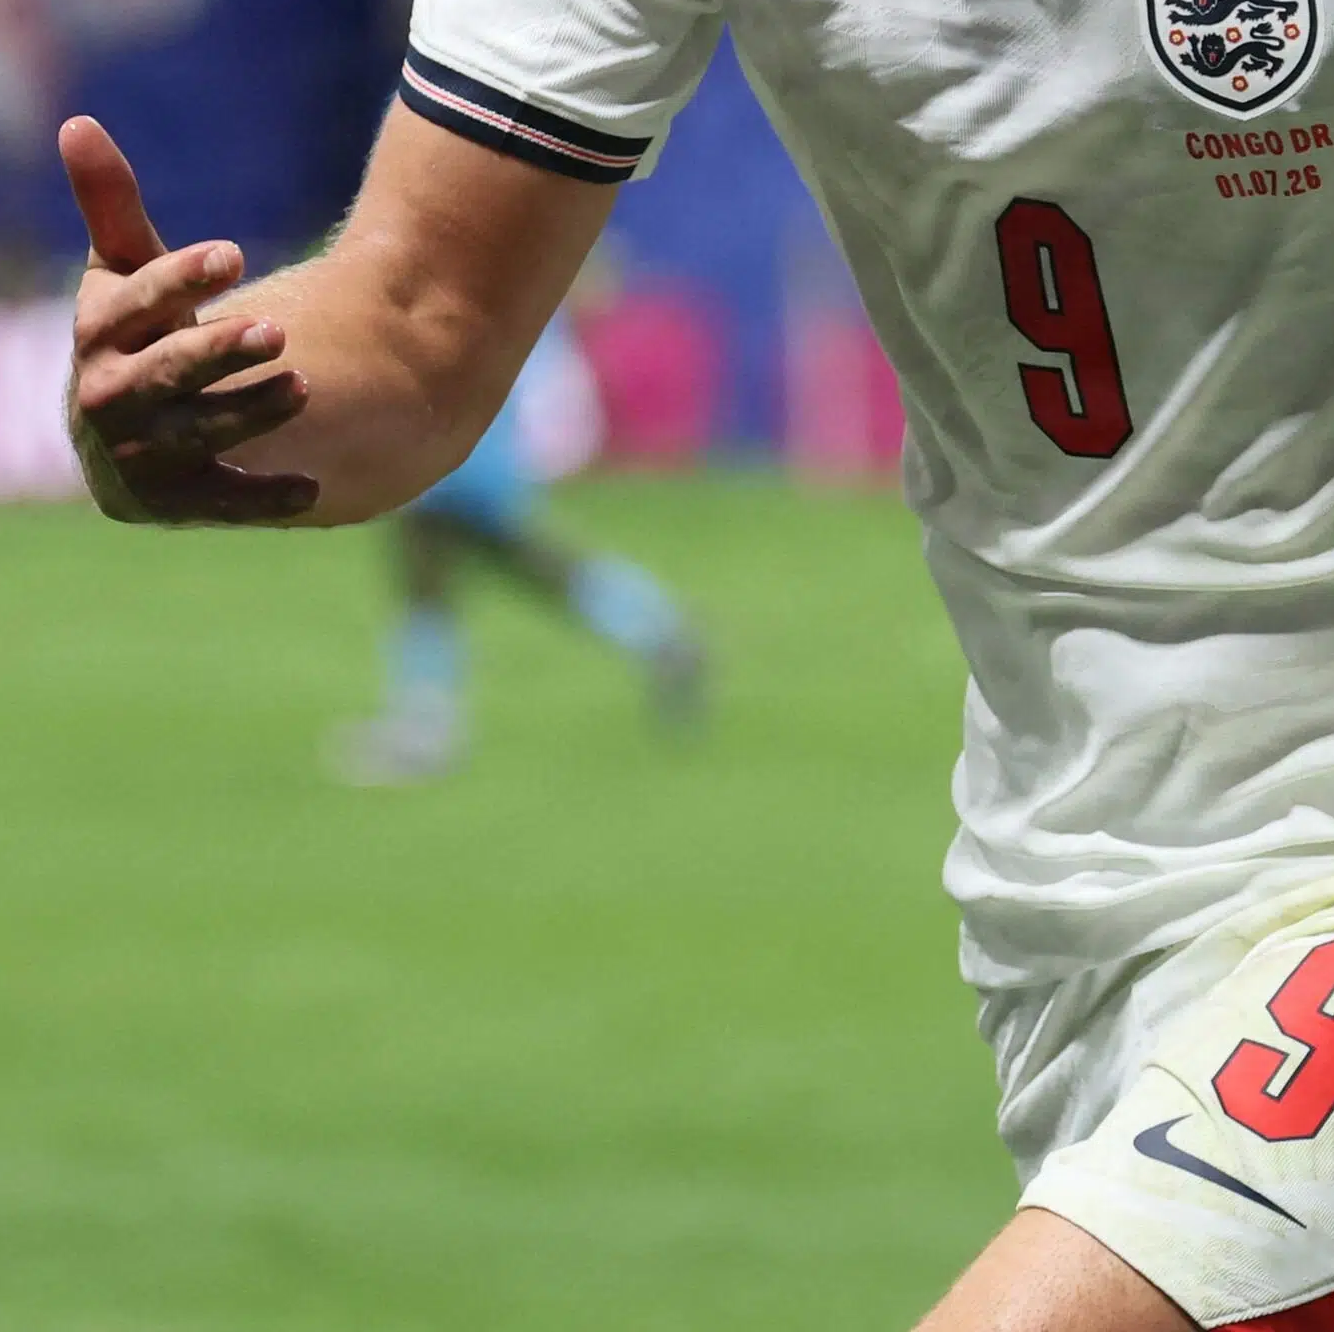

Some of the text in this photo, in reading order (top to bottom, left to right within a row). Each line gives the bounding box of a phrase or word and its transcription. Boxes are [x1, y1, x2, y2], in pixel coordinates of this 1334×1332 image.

[1185, 123, 1334, 160] CONGO DR
[1215, 165, 1322, 199] 01.07.26
[995, 197, 1134, 459] 9
